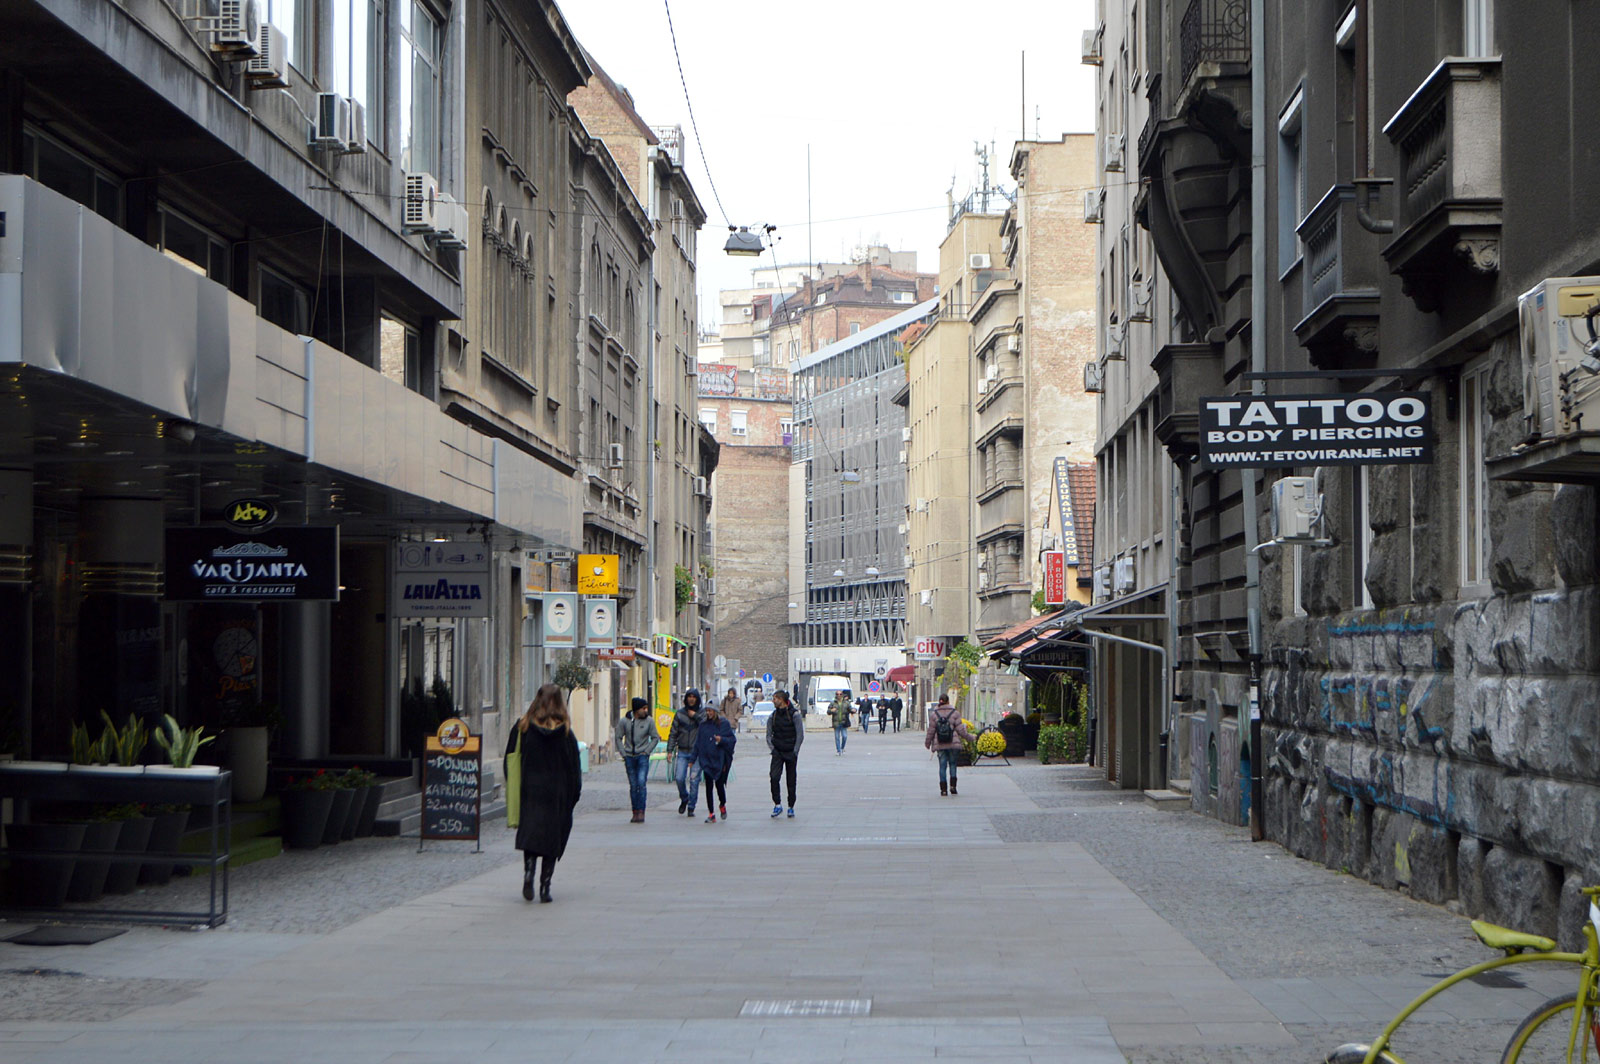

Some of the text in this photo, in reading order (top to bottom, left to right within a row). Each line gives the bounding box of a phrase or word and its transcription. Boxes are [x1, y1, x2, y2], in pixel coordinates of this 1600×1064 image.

[1206, 397, 1426, 427] TATTOO
[1208, 426, 1424, 444] BODY PIERCING
[1209, 446, 1424, 463] WWW.TETOVIRANJE.NET
[1065, 530, 1078, 562] ROOMS
[205, 586, 228, 594] cafe
[242, 586, 296, 594] restaurant
[404, 578, 482, 600] LAVAZZA
[917, 638, 944, 656] city
